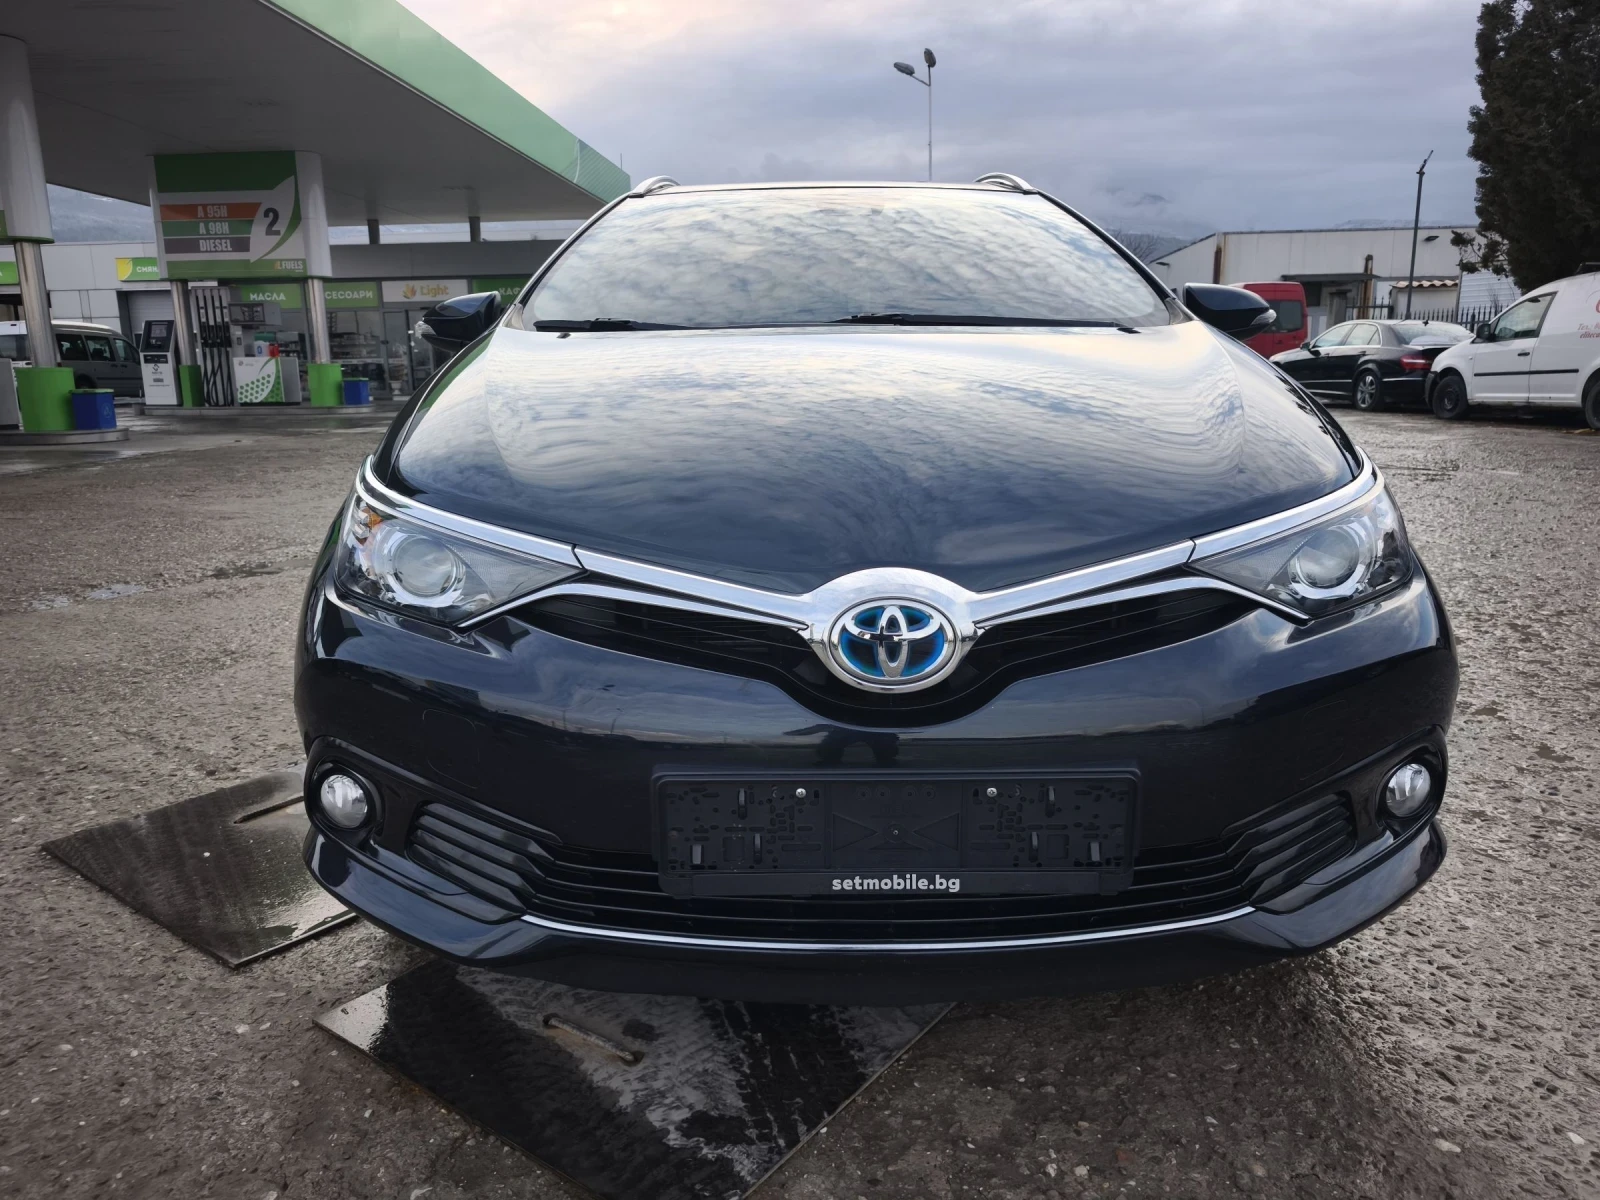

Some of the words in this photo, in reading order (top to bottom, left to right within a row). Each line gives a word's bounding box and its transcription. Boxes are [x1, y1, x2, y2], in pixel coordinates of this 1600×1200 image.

[263, 207, 282, 236] 2
[199, 239, 233, 252] DIESEL
[136, 265, 160, 273] СМЯН
[249, 292, 286, 301] МАСЛА
[420, 284, 450, 298] Light
[832, 873, 961, 893] setmobile.bg
